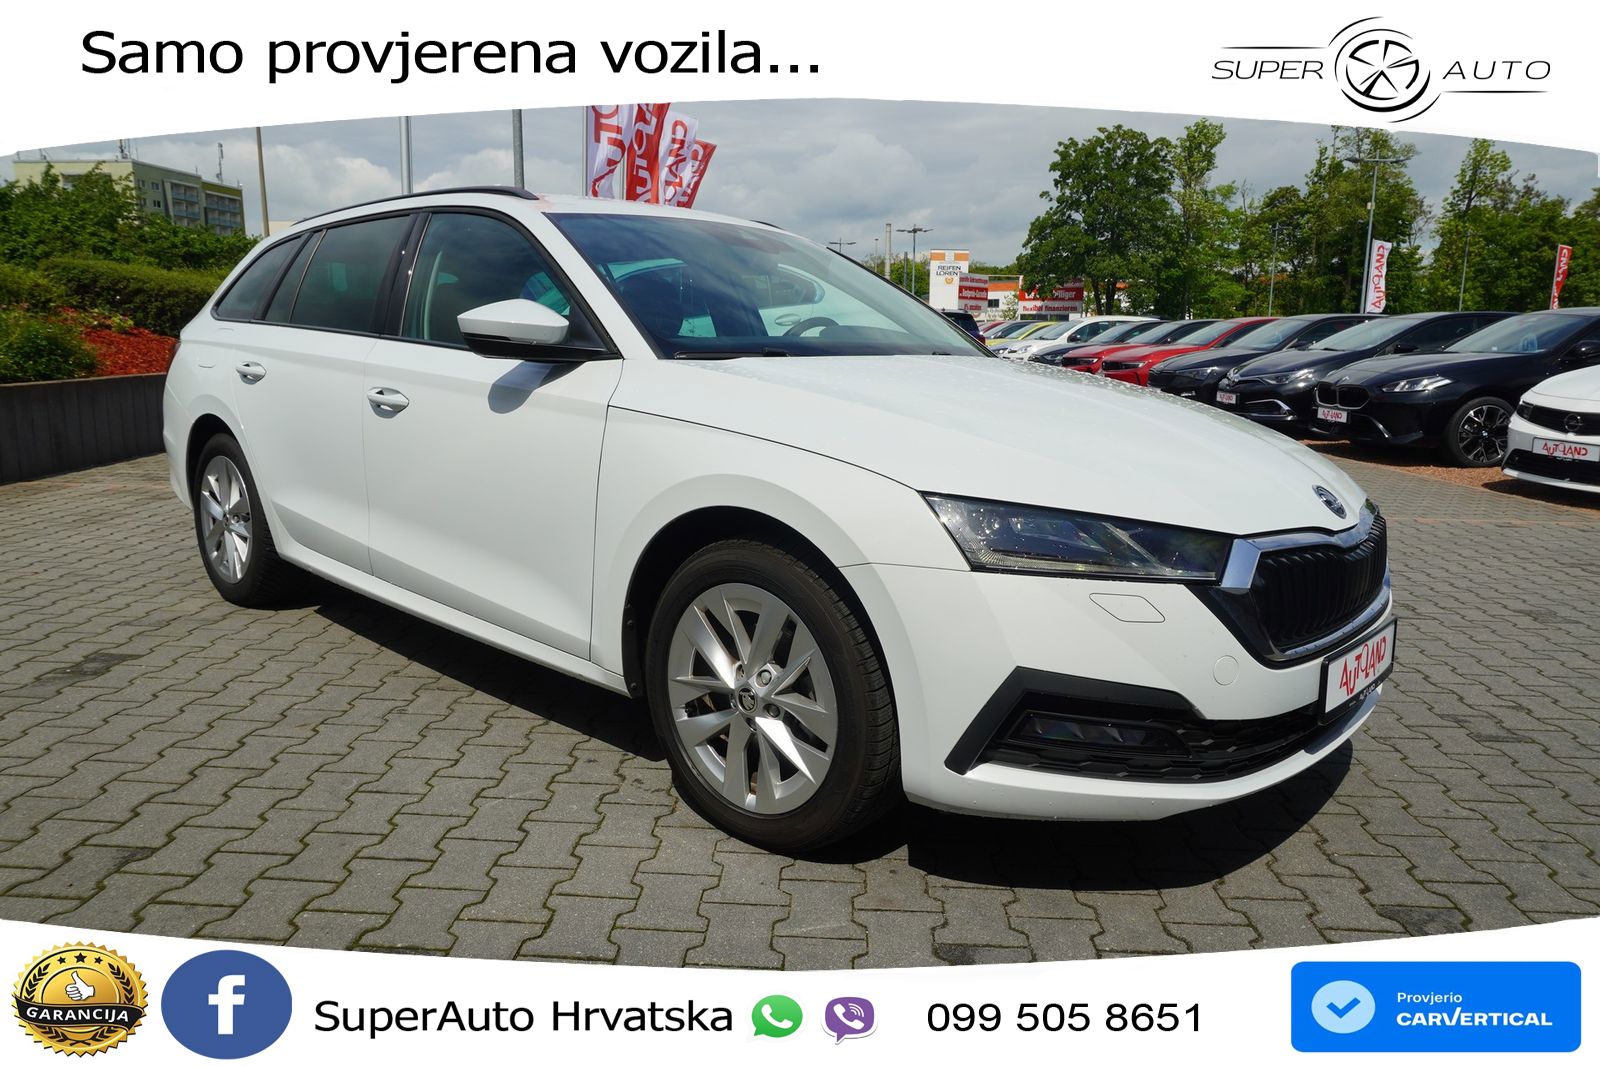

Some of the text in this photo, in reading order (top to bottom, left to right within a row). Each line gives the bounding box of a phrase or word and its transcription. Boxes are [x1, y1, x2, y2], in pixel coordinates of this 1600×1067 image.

[1370, 244, 1386, 309] AUTOLAND
[1541, 441, 1588, 457] AUTOLAND
[1339, 636, 1387, 696] AUTOLAND
